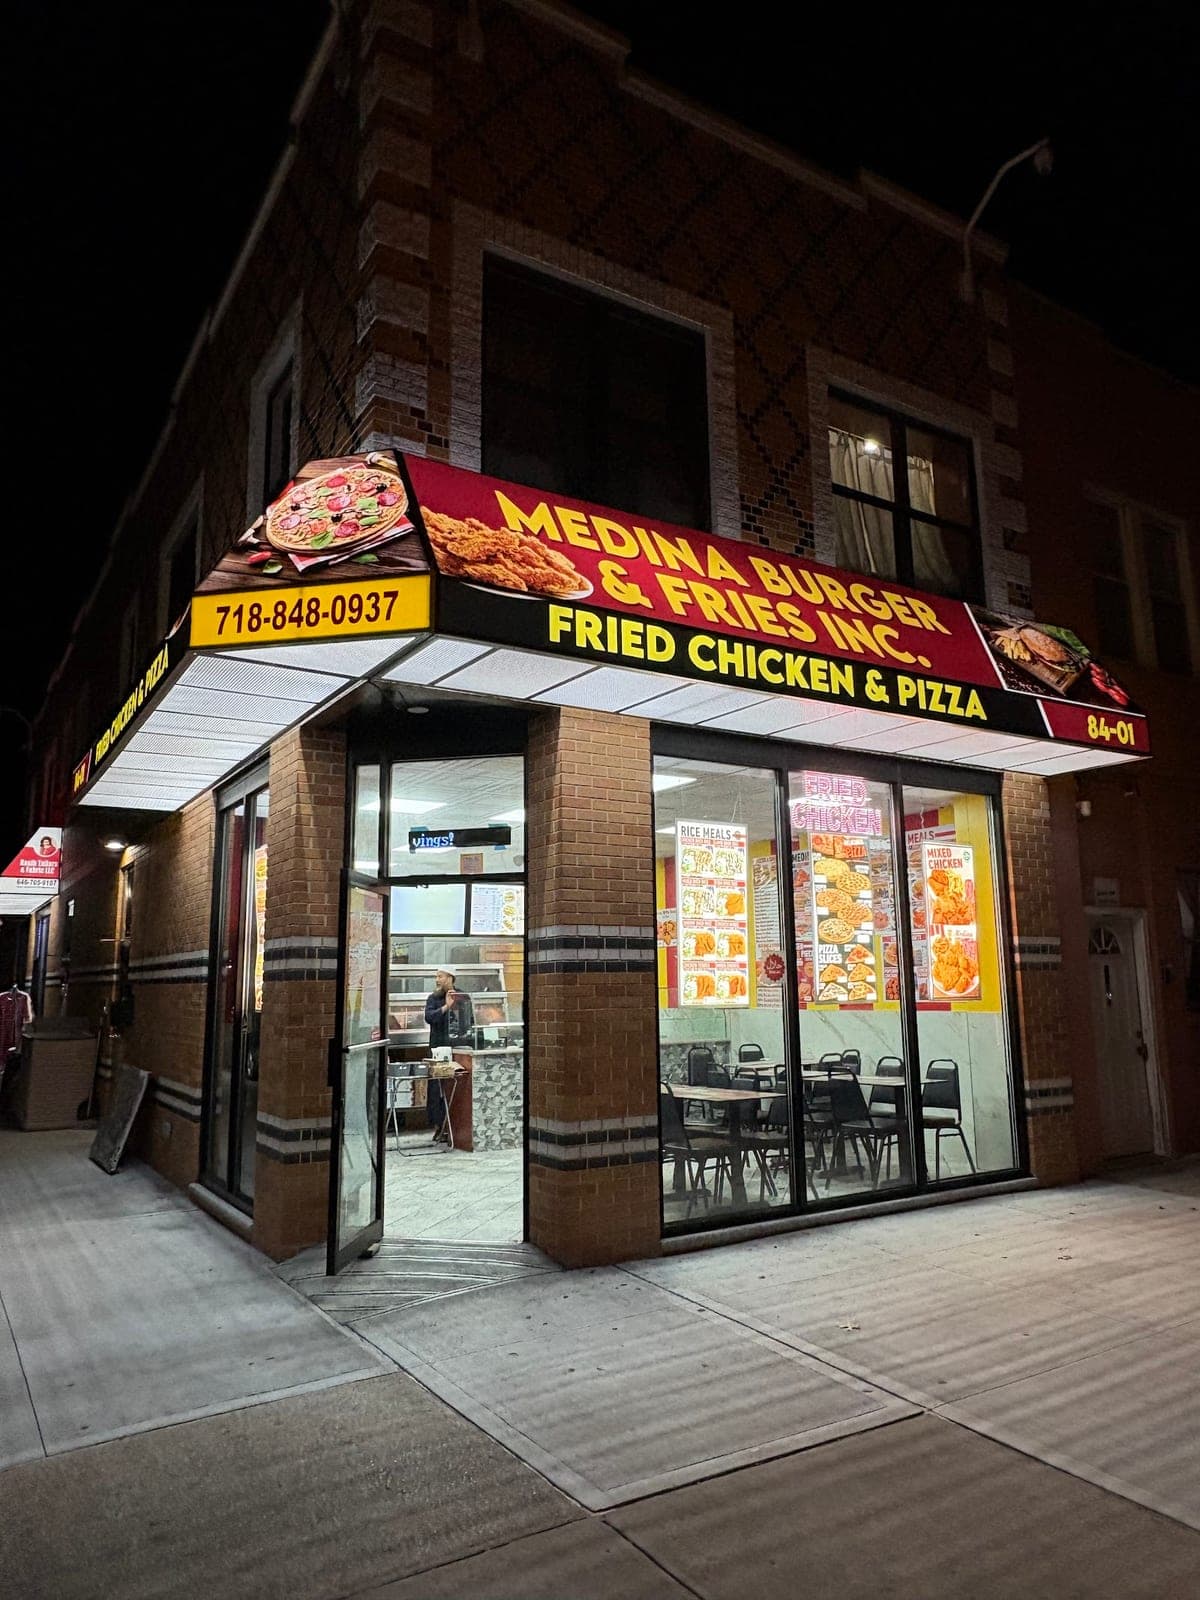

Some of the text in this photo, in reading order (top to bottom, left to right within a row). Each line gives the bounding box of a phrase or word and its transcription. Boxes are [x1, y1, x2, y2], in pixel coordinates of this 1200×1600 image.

[494, 489, 952, 636] MEDINA BURGER
[215, 589, 400, 637] 718-848-0937
[598, 559, 932, 669] & FRIES INC.
[145, 642, 169, 698] PIZZA
[548, 603, 987, 721] FRIED CHICKEN & PIZZA
[1086, 714, 1135, 746] 84-01
[805, 773, 868, 807] FRIED
[681, 825, 732, 840] RICE MEALS
[792, 803, 882, 836] CHICKEN
[927, 848, 952, 859] MIXED
[928, 858, 963, 870] CHICKEN
[819, 944, 839, 954] PIZZA
[819, 953, 843, 965] SLICES
